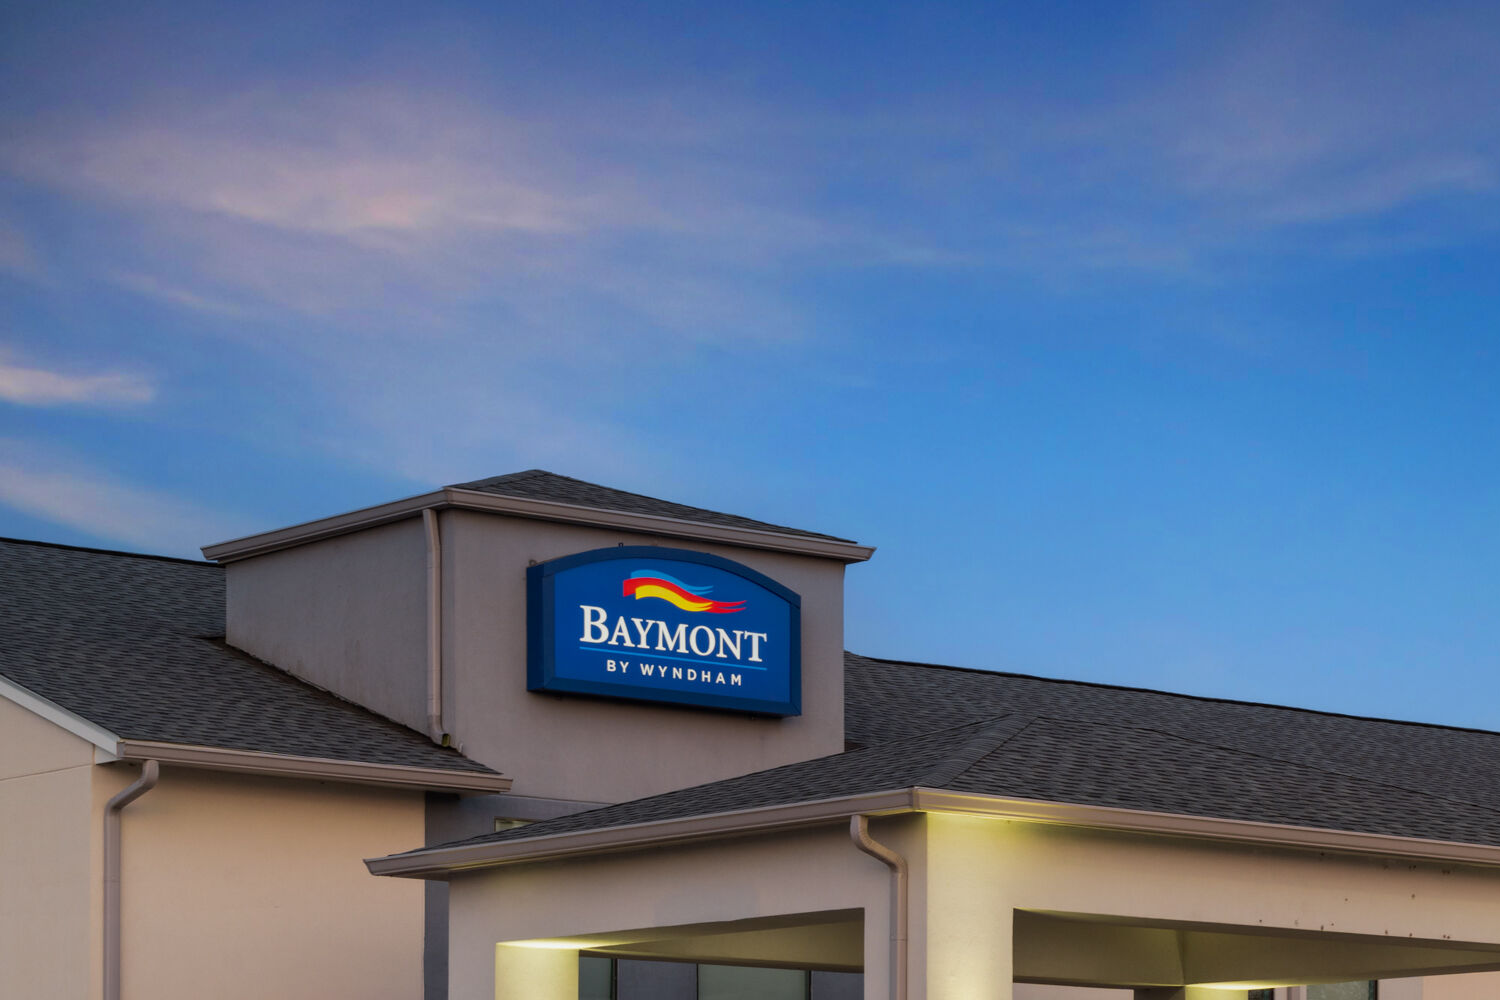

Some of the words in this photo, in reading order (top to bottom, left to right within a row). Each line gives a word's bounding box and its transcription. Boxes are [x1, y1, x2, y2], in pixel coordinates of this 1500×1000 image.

[579, 604, 767, 662] BAYMONT
[606, 659, 629, 673] BY
[640, 663, 742, 686] WYNDHAM
